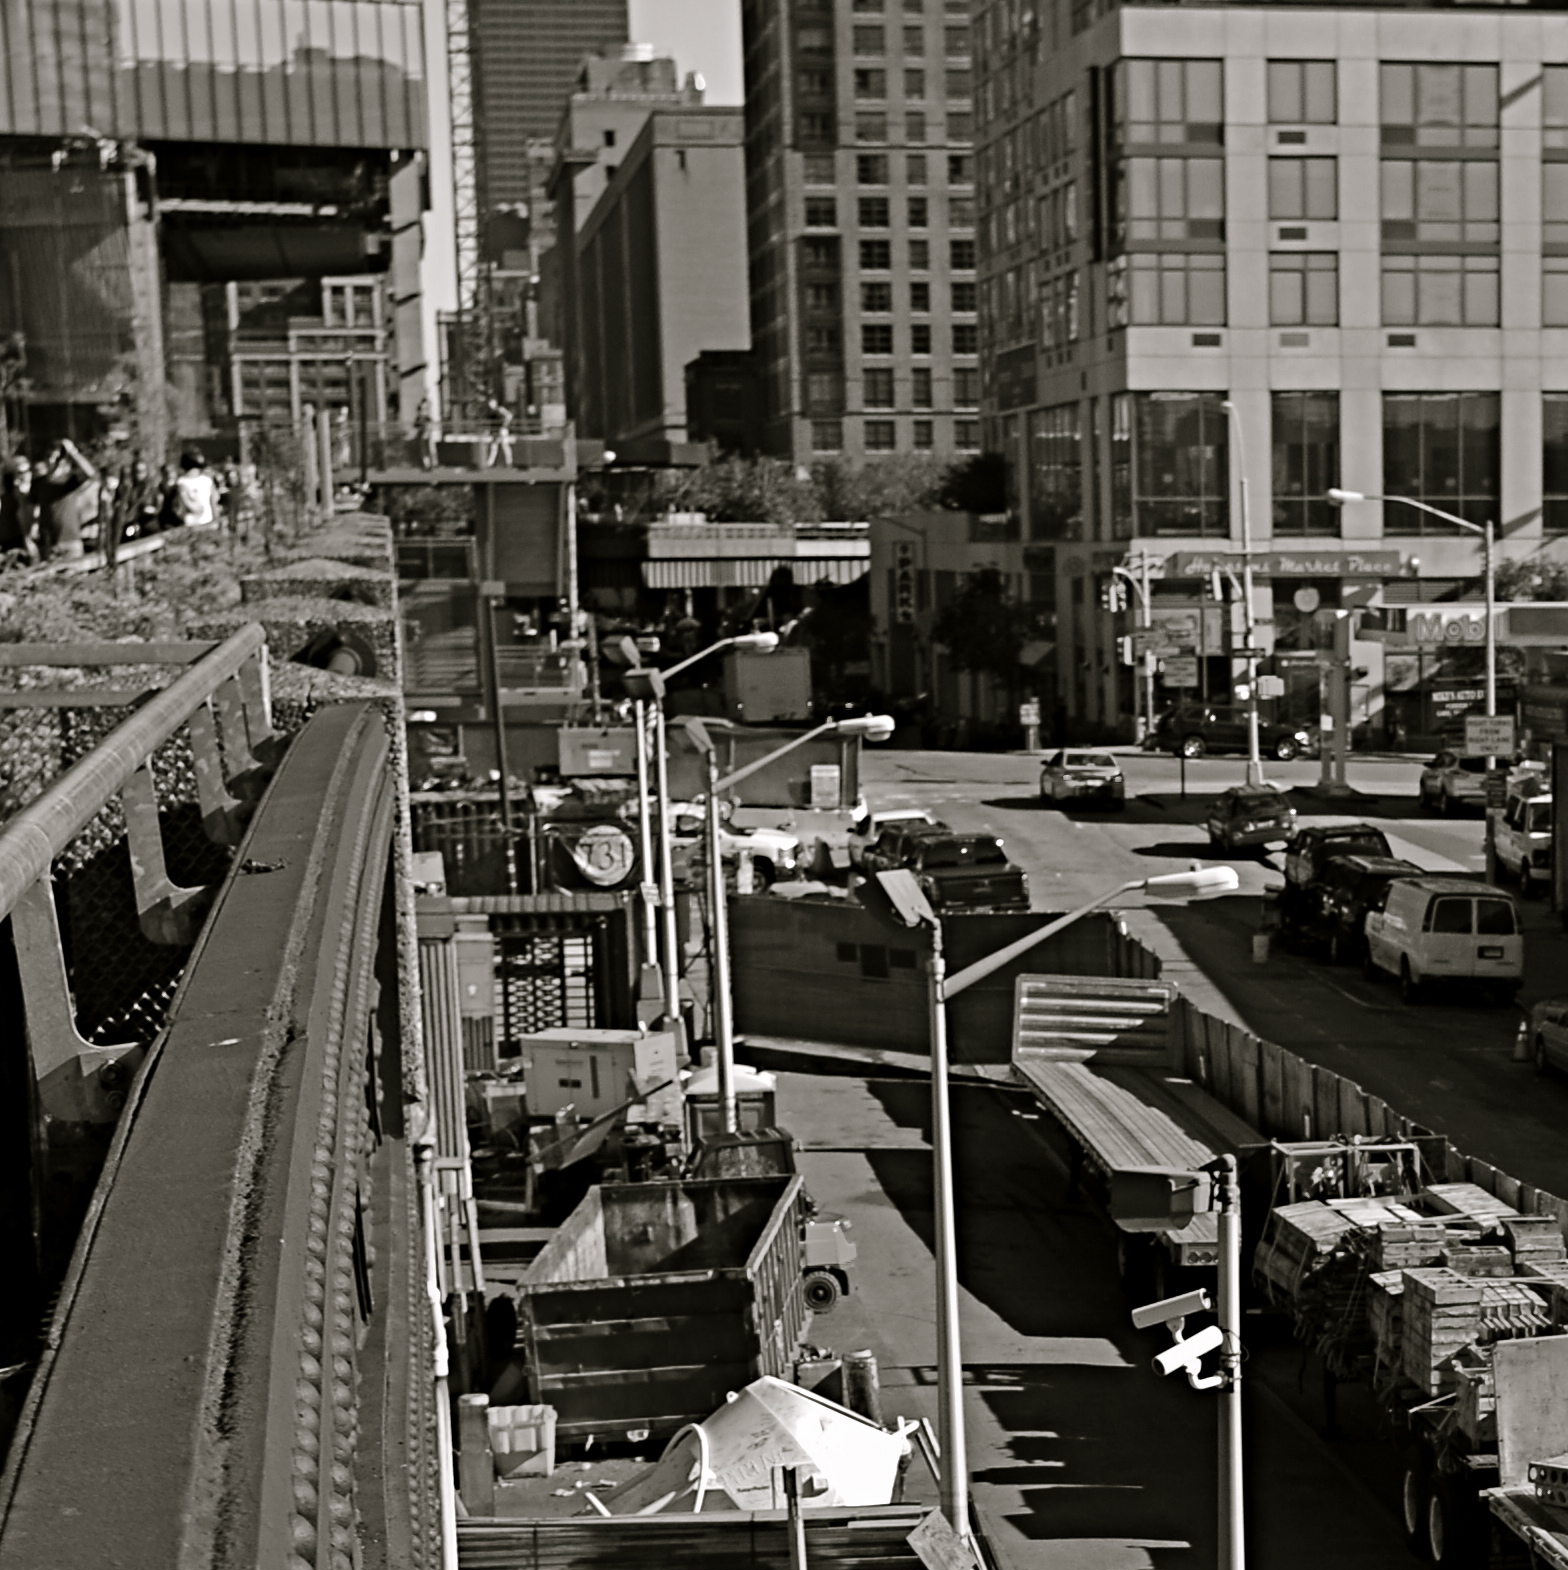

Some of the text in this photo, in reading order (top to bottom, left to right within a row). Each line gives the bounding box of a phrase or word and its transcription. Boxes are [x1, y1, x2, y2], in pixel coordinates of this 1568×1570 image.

[1280, 556, 1341, 574] Market
[1347, 556, 1393, 574] Place
[1416, 612, 1503, 642] Mobl
[581, 840, 627, 871] 731
